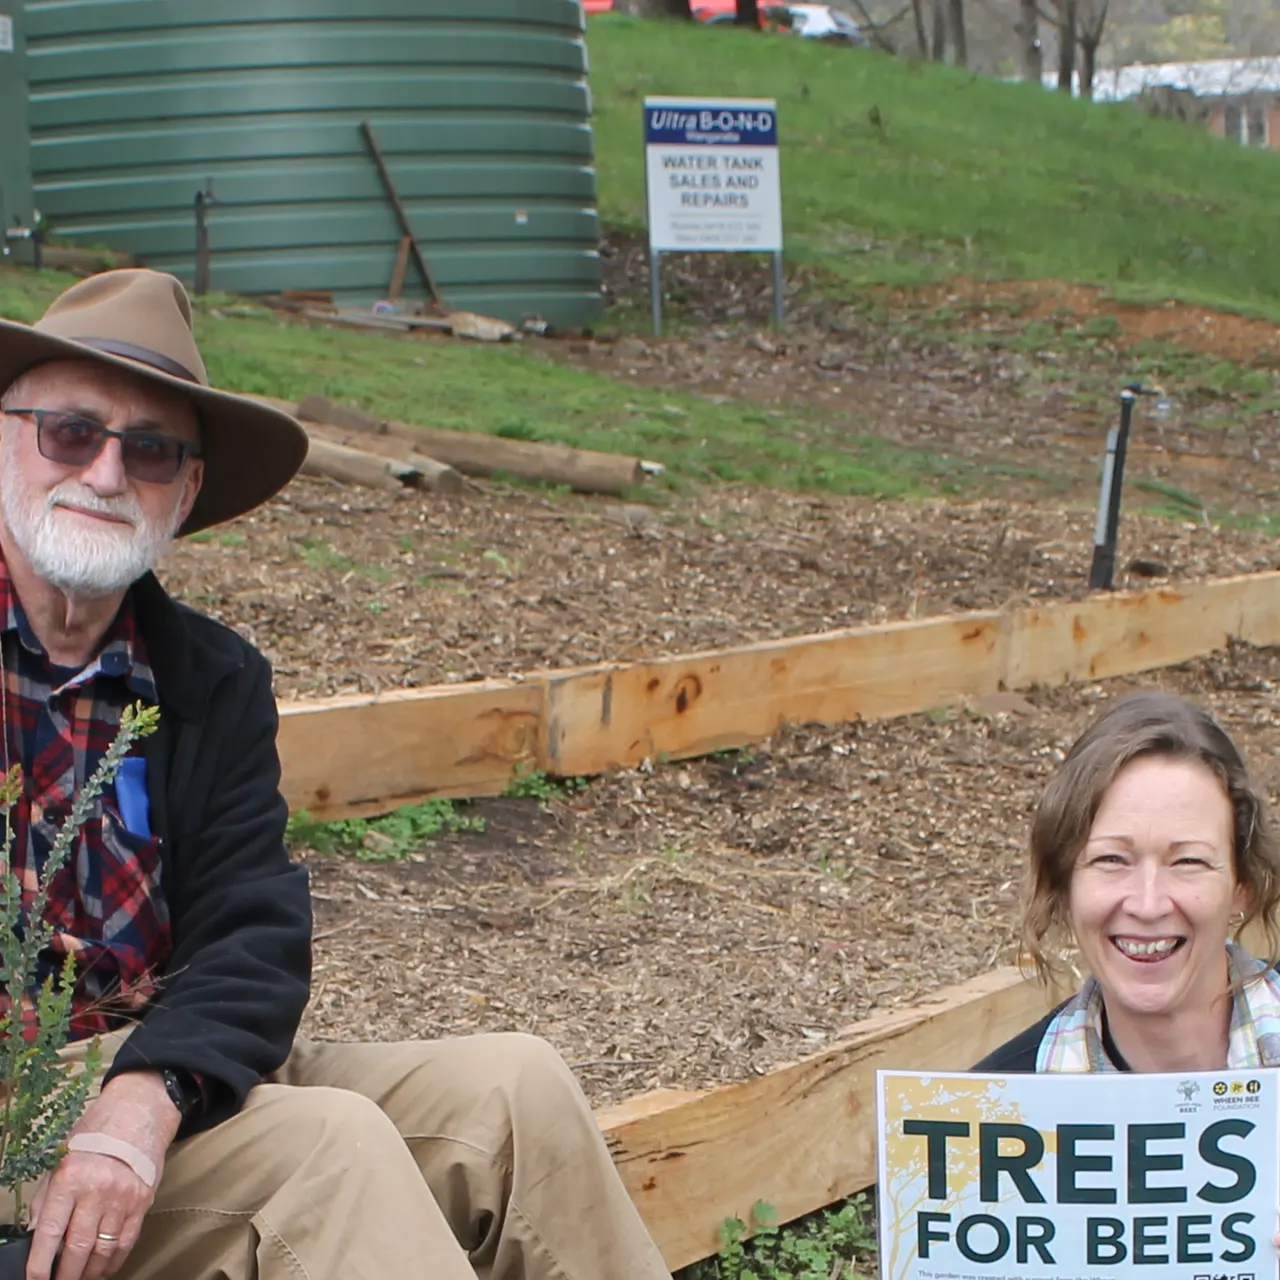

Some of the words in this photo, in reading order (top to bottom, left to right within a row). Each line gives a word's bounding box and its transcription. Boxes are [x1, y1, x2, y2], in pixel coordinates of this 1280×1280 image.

[651, 110, 697, 130] Ultra
[663, 155, 717, 169] WATER
[723, 157, 763, 170] TANK
[669, 174, 721, 189] SALES
[726, 175, 759, 189] AND
[681, 191, 748, 208] REPAIRS
[1213, 1096, 1243, 1104] WHEEN
[1213, 1103, 1261, 1111] FOUNDATION
[903, 1118, 1257, 1204] TREES
[917, 1211, 1056, 1265] FOR
[1086, 1212, 1256, 1265] BEES
[918, 1270, 933, 1278] This
[934, 1272, 960, 1280] garden
